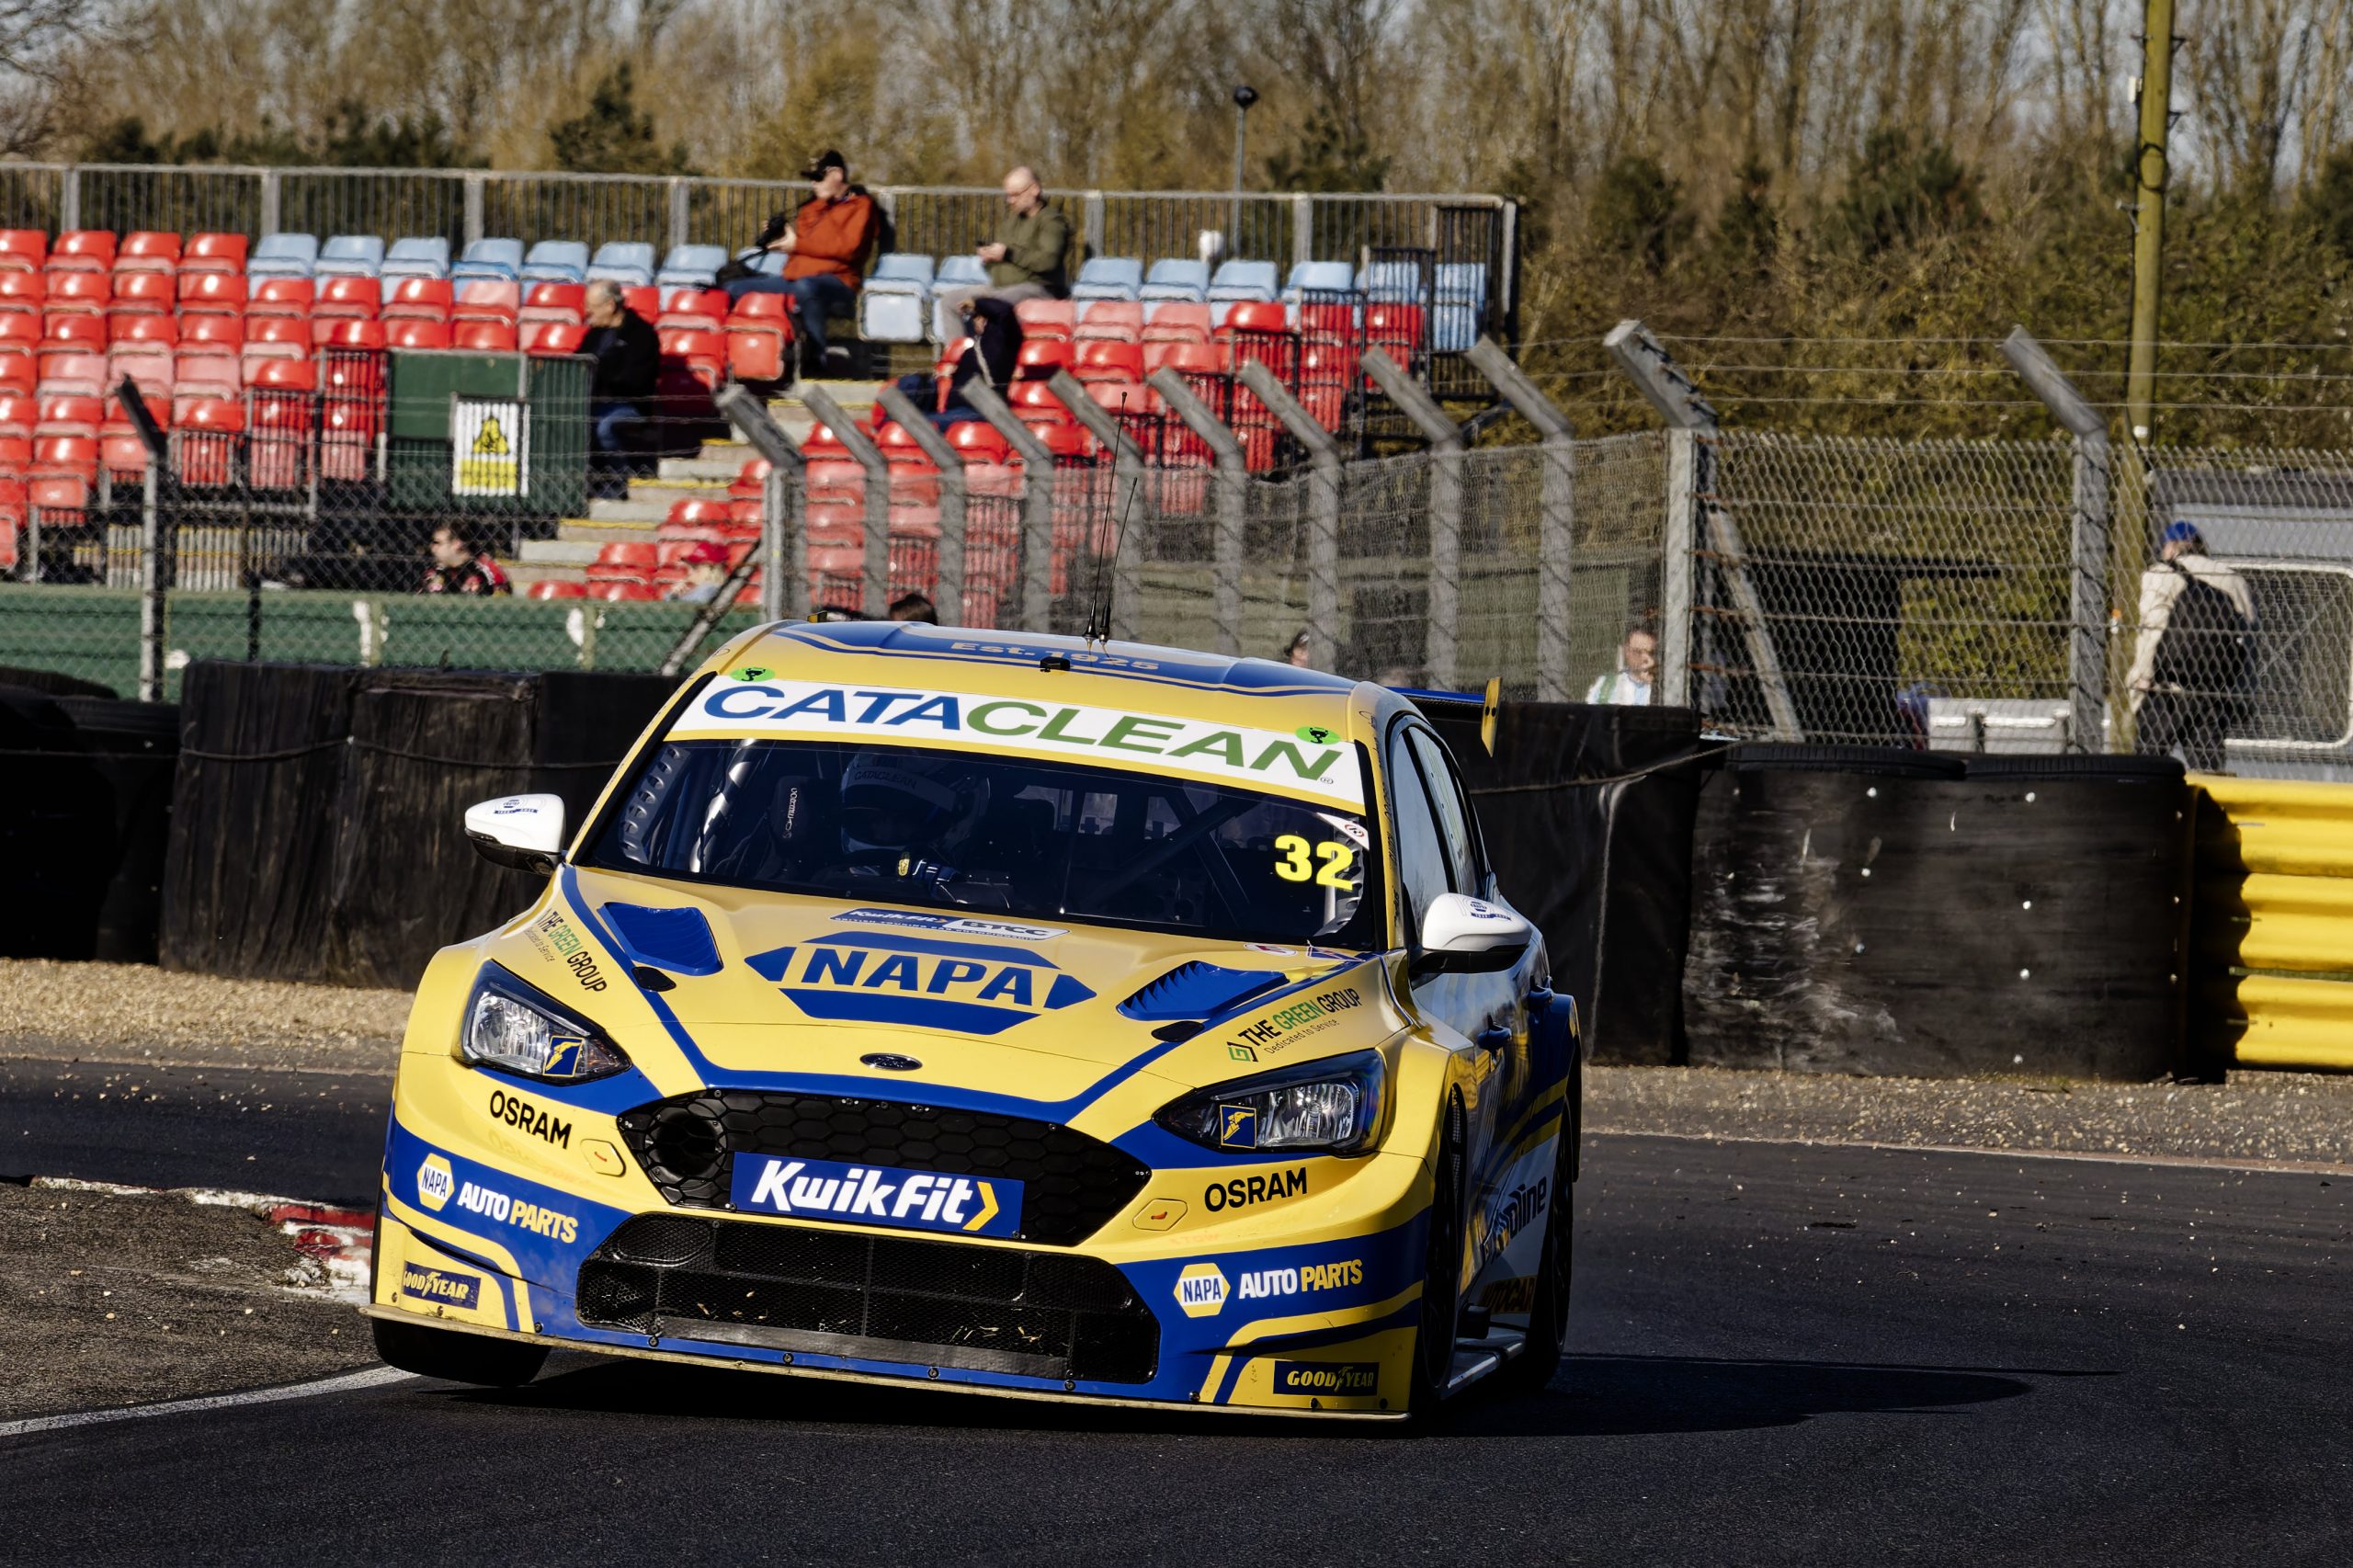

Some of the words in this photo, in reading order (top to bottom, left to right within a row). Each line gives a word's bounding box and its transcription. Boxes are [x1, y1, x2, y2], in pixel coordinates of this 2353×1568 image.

[950, 642, 1035, 657] Est.
[1046, 651, 1160, 671] 1925
[704, 686, 1343, 781] CATACLEAN
[1275, 835, 1353, 891] 32
[548, 924, 585, 957] GREEN
[566, 950, 608, 992] GROUP
[801, 948, 1033, 1006] NAPA
[1237, 1019, 1282, 1046] THE
[1272, 999, 1325, 1030] GREEN
[1316, 987, 1363, 1013] GROUP
[1264, 1030, 1305, 1054] Dedicated
[1302, 1028, 1314, 1037] to
[1310, 1018, 1340, 1033] Service
[489, 1089, 573, 1150] OSRAM
[421, 1166, 449, 1199] NAPA
[457, 1182, 510, 1222] AUTO
[508, 1199, 579, 1244] PARTS
[1204, 1167, 1308, 1212] OSRAM
[1183, 1278, 1222, 1303] NAPA
[1238, 1268, 1298, 1300] AUTO
[1301, 1259, 1363, 1292] PARTS
[1287, 1368, 1374, 1391] GOODYEAR
